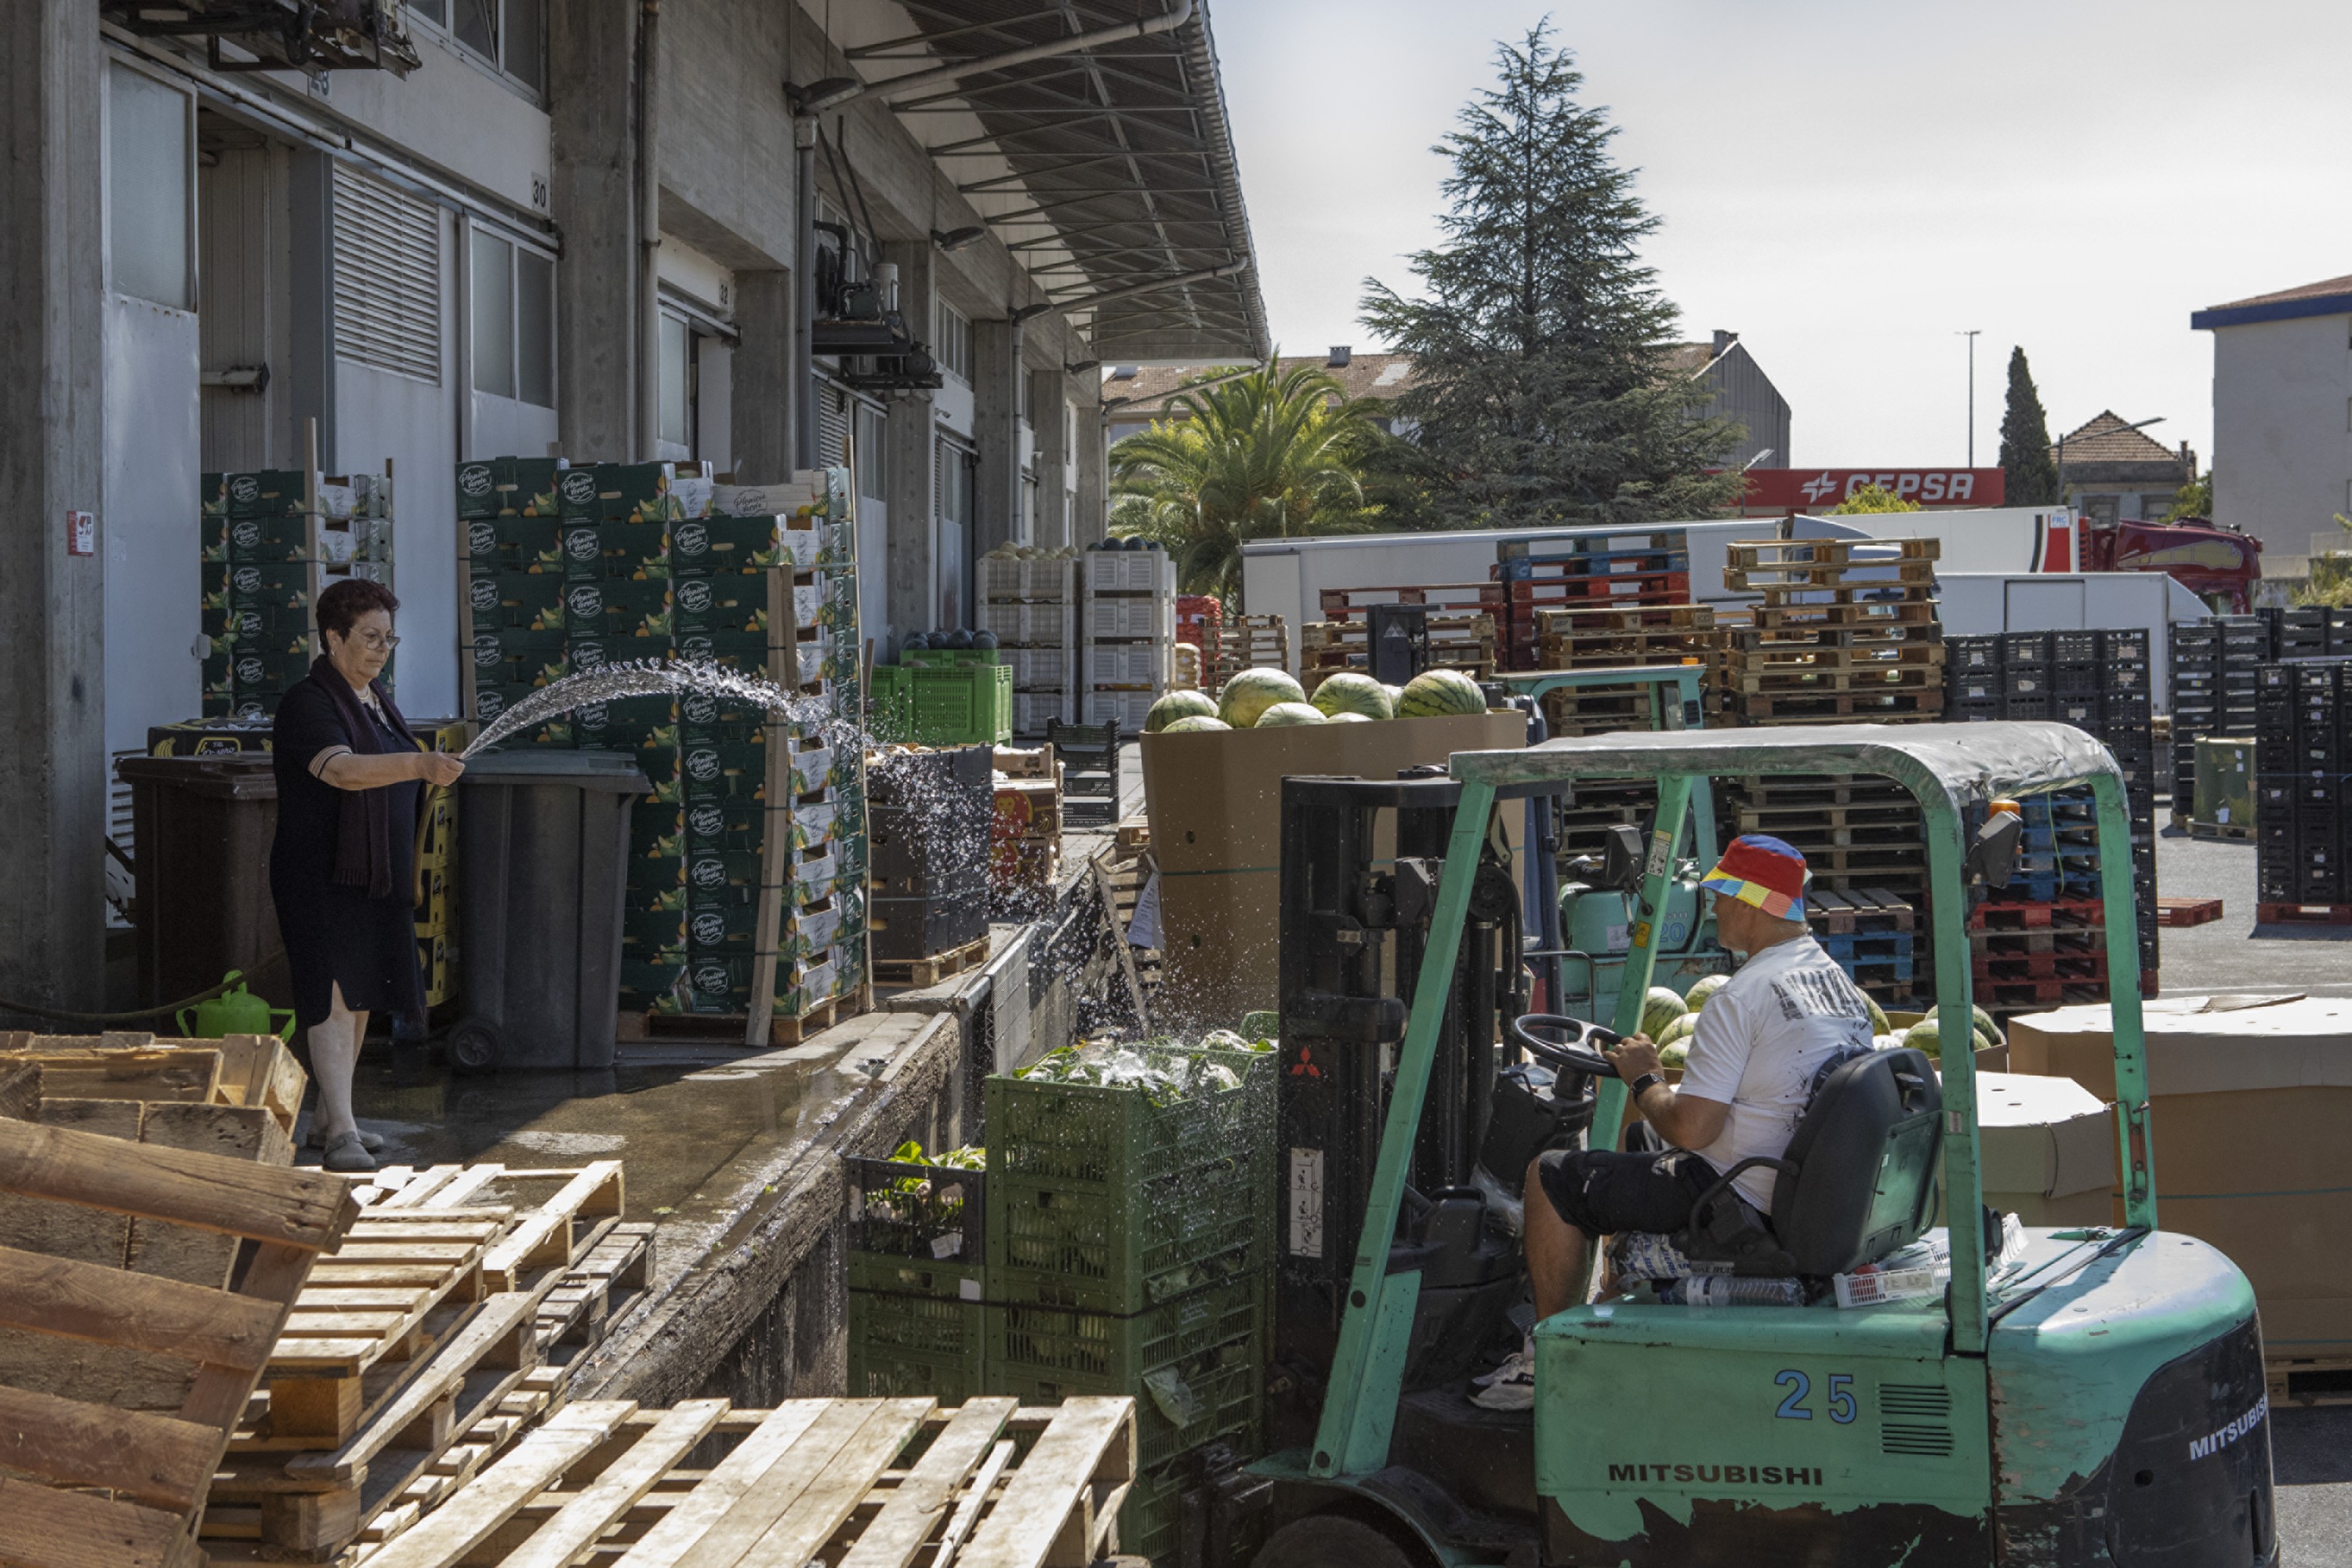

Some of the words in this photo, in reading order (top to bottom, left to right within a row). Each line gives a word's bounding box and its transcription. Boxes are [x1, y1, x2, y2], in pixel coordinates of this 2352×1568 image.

[532, 180, 546, 209] 30
[720, 284, 728, 305] 32
[1845, 473, 1974, 500] CEPSA
[1660, 923, 1686, 942] 20
[1774, 1369, 1857, 1425] 25
[1608, 1464, 1824, 1486] MITSUBISHI
